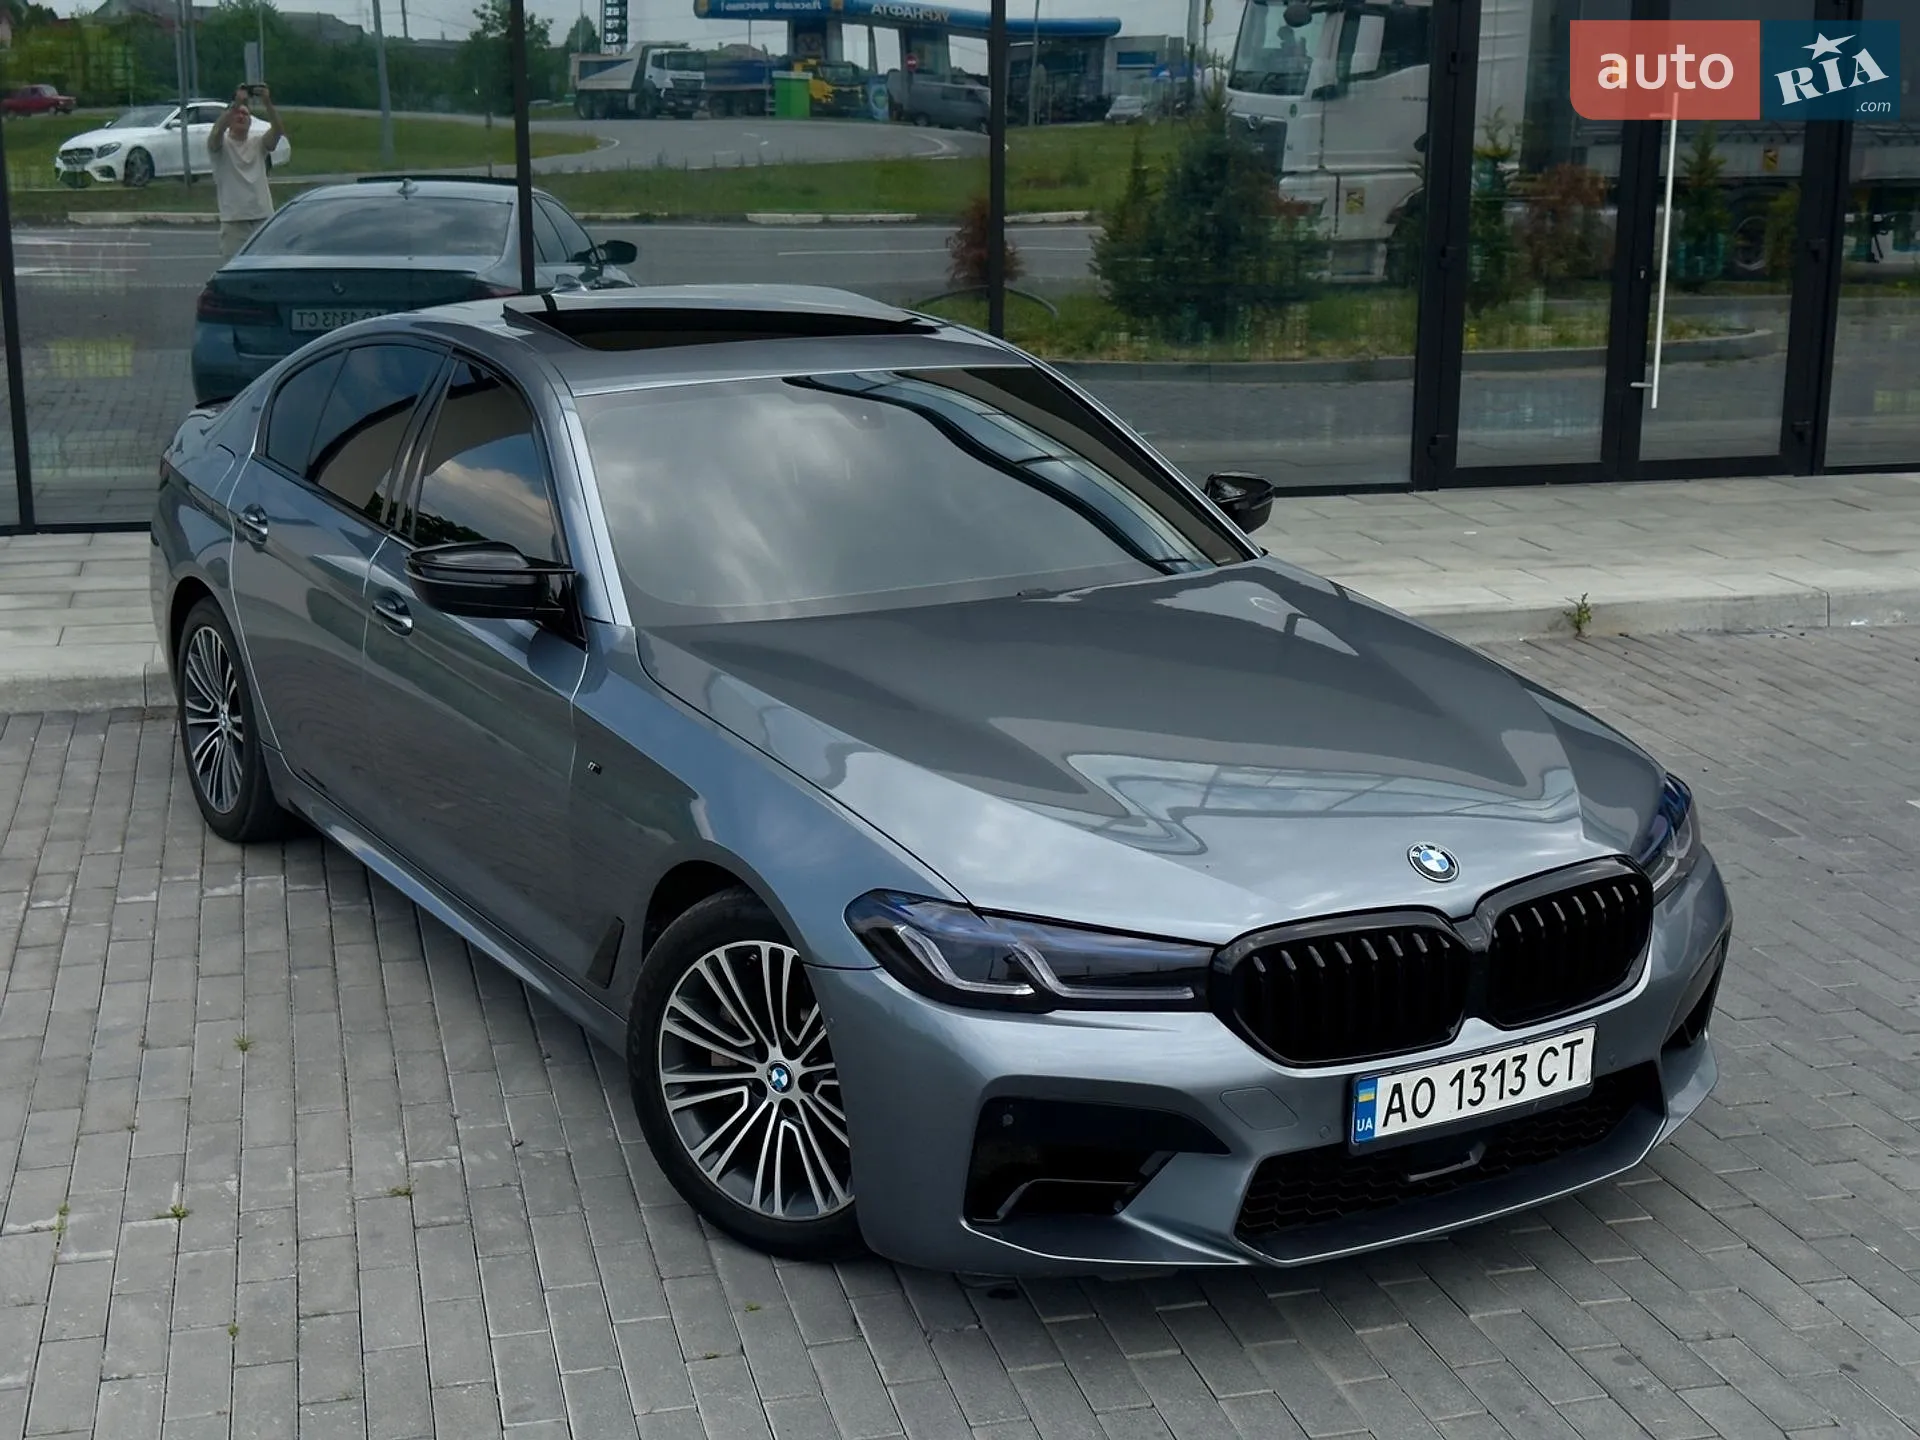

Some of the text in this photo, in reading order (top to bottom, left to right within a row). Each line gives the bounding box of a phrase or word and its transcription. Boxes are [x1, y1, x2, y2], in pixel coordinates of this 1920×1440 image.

[1382, 1037, 1584, 1127] AO 1313 CT
[1356, 1120, 1373, 1132] UA
